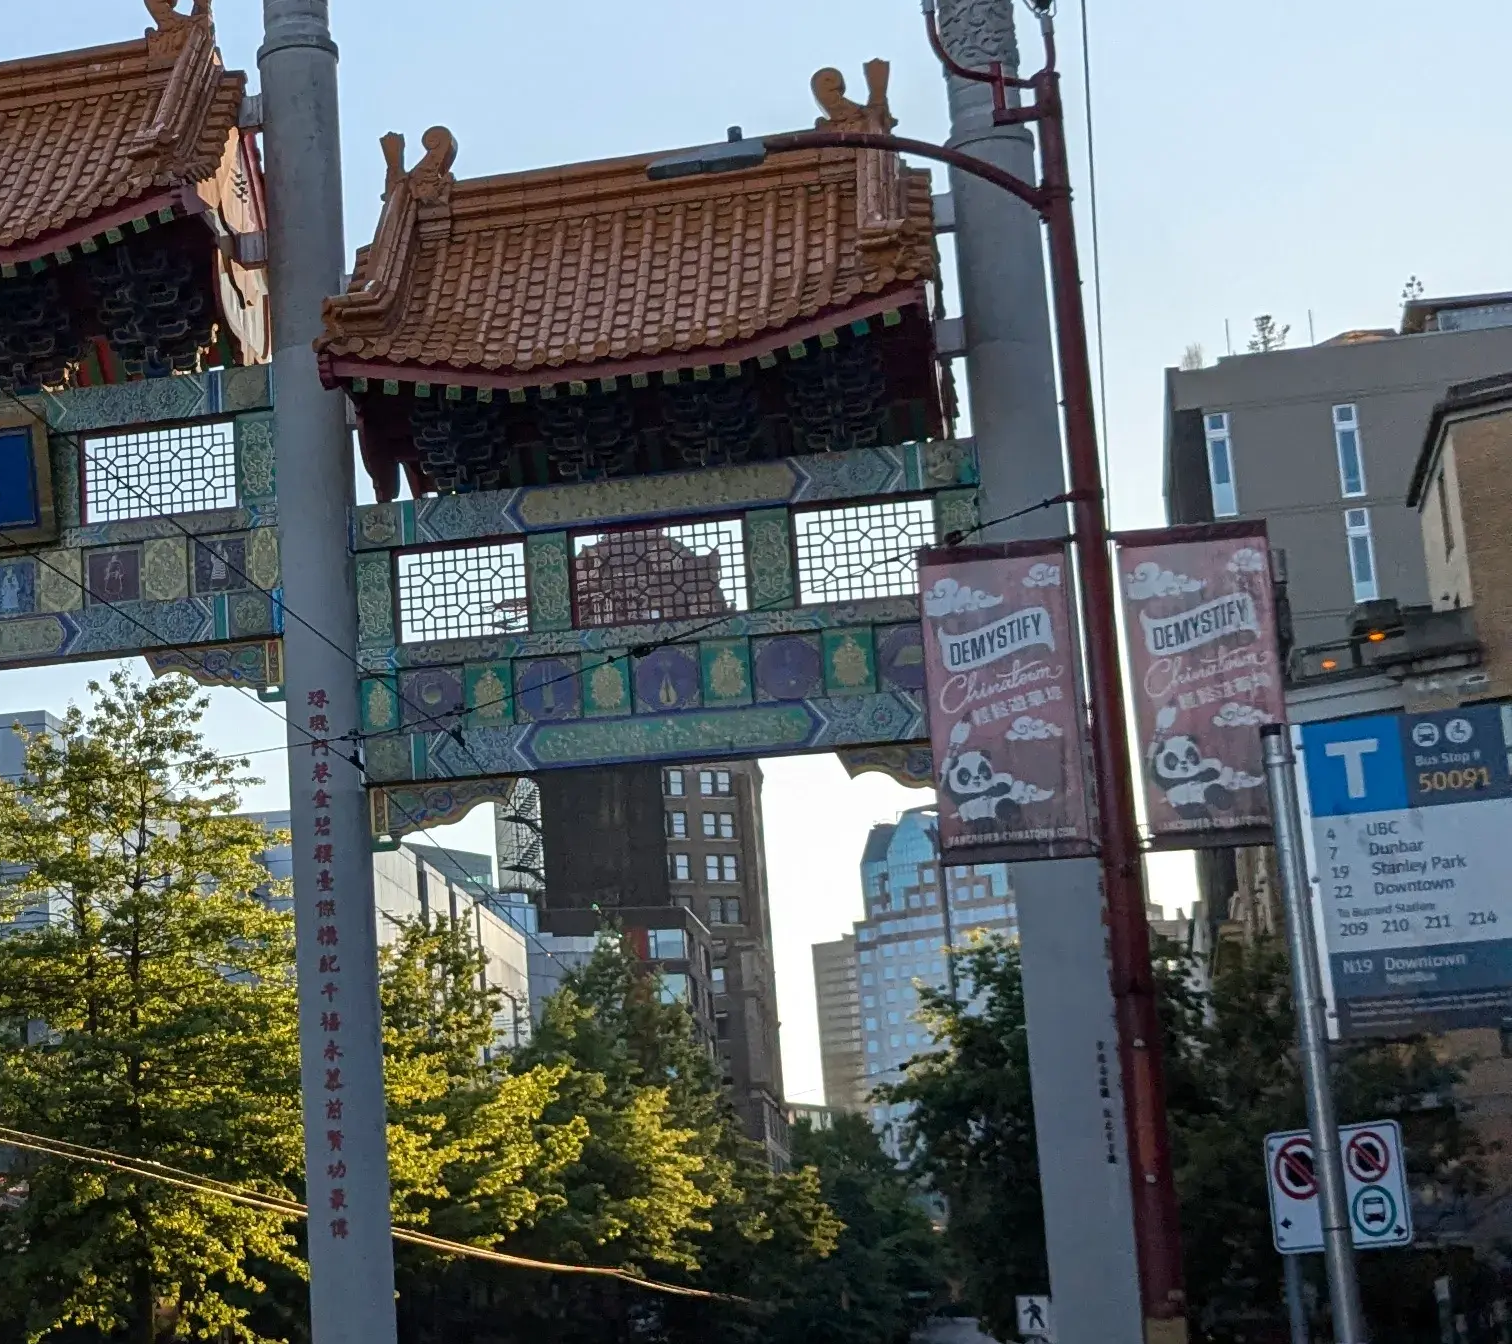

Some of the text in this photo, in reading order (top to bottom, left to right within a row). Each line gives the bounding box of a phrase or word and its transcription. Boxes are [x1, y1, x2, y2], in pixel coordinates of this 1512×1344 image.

[1153, 598, 1248, 650] DEMYSTIFY
[949, 612, 1042, 667] DEMYSTIFY
[1143, 645, 1274, 697] Chinatown
[940, 659, 1064, 714] Chinatown
[1325, 738, 1378, 799] T
[1415, 754, 1438, 767] Bus
[1441, 752, 1470, 766] Stop
[1418, 766, 1491, 793] 50091
[1326, 821, 1399, 840] 4 UBC
[1328, 839, 1424, 860] 7 Dunbar
[1331, 855, 1468, 879] 19 Stanley Park
[1334, 878, 1455, 899] 22 Downtown
[1340, 910, 1498, 937] 209 210 211 214
[1343, 954, 1467, 974] N19 Downtown
